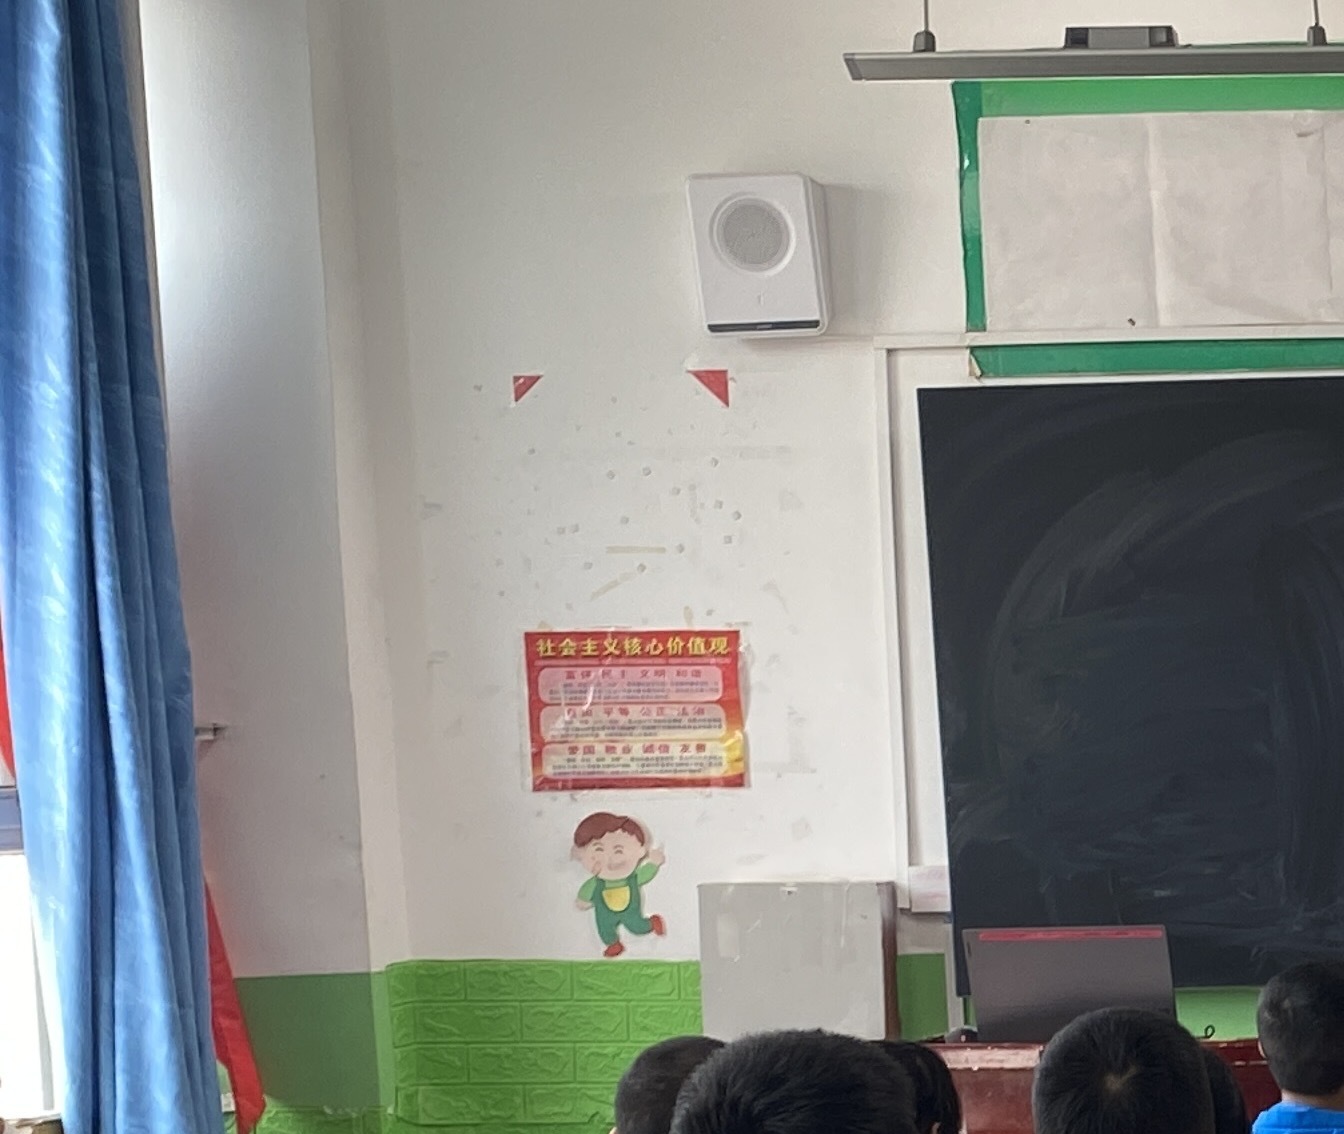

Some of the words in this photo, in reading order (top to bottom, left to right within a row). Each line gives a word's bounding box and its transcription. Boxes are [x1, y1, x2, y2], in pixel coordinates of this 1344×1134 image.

[536, 636, 730, 657] 社会主义核心价值观
